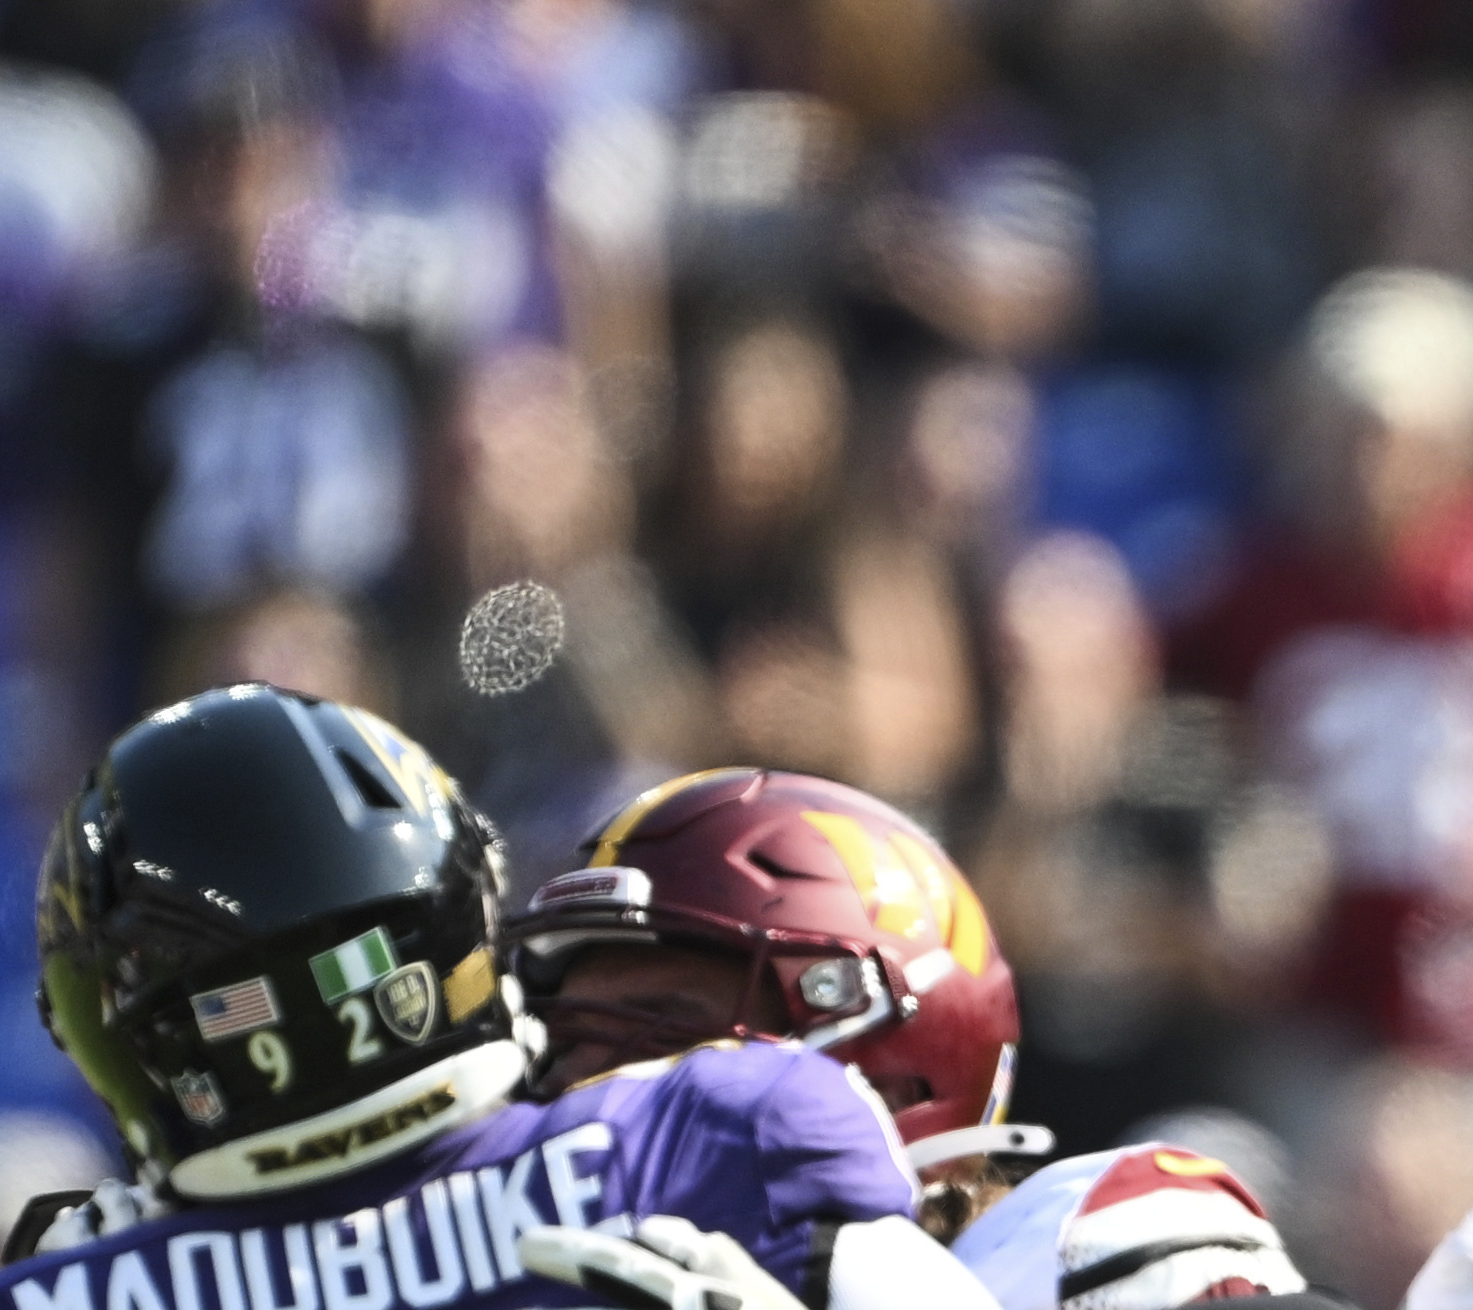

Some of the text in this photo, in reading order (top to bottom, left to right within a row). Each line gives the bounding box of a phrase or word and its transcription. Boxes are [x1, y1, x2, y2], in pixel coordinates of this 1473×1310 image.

[247, 1030, 293, 1092] 9
[337, 998, 382, 1064] 2
[246, 1082, 456, 1175] RAVENS
